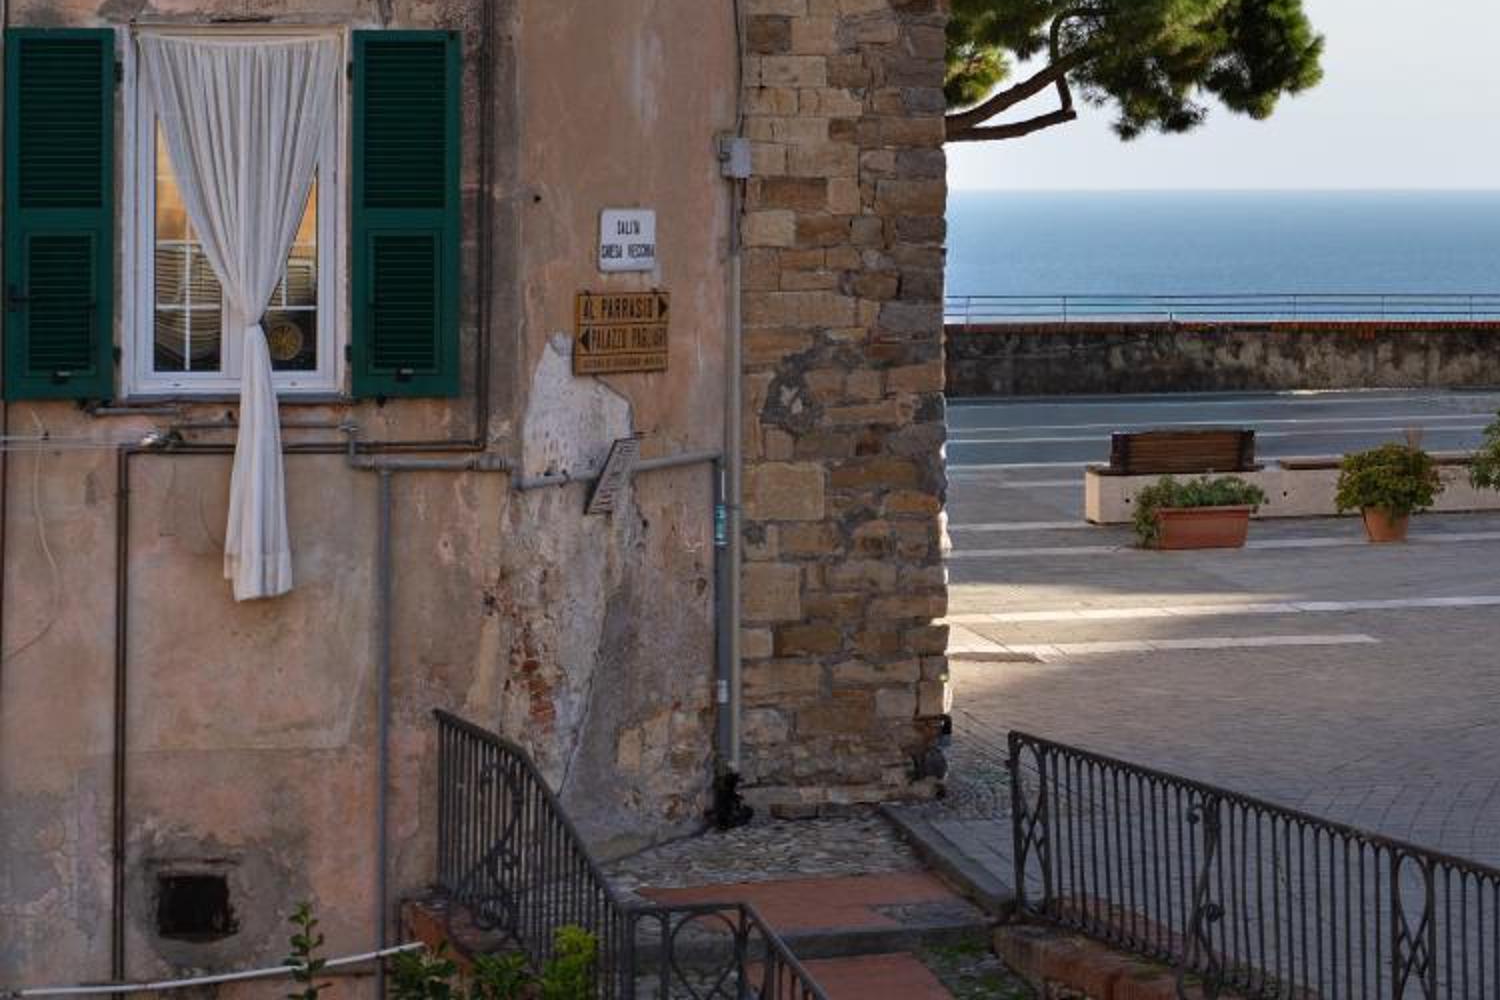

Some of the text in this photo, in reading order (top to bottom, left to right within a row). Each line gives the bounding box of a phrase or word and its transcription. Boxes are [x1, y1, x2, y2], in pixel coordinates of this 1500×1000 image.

[583, 296, 653, 320] AL PARRASIO
[591, 327, 627, 351] PALAZZO
